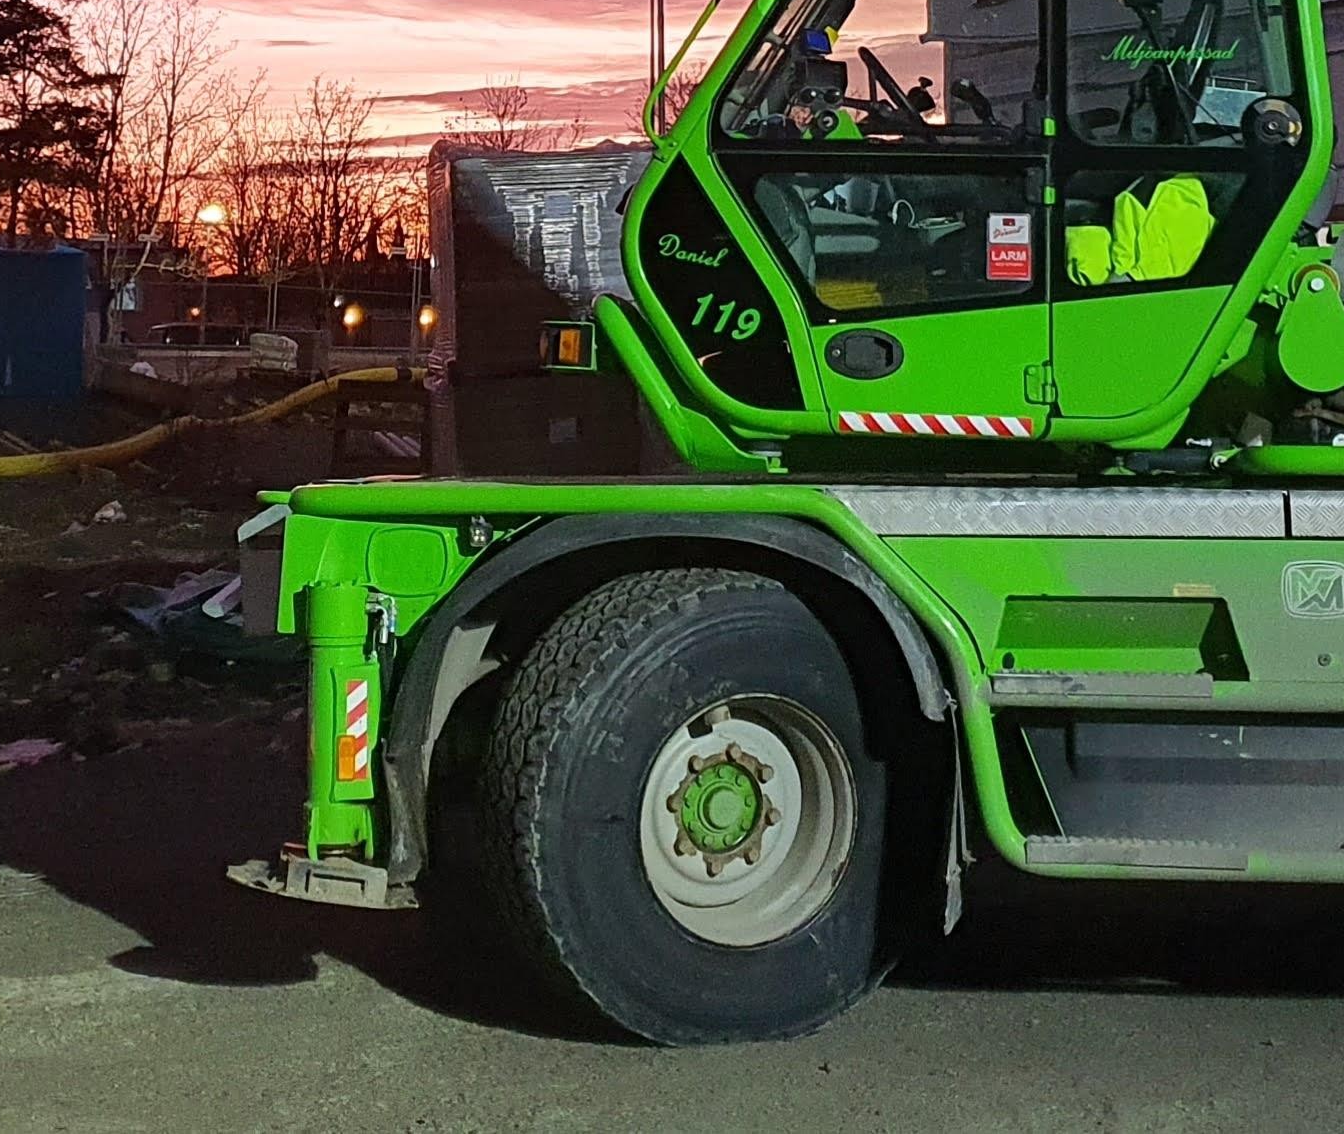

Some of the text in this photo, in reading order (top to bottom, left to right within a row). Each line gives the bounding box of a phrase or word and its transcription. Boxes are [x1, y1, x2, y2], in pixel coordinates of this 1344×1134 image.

[658, 233, 729, 267] Daniel
[991, 250, 1027, 261] LARM
[691, 292, 761, 340] 119
